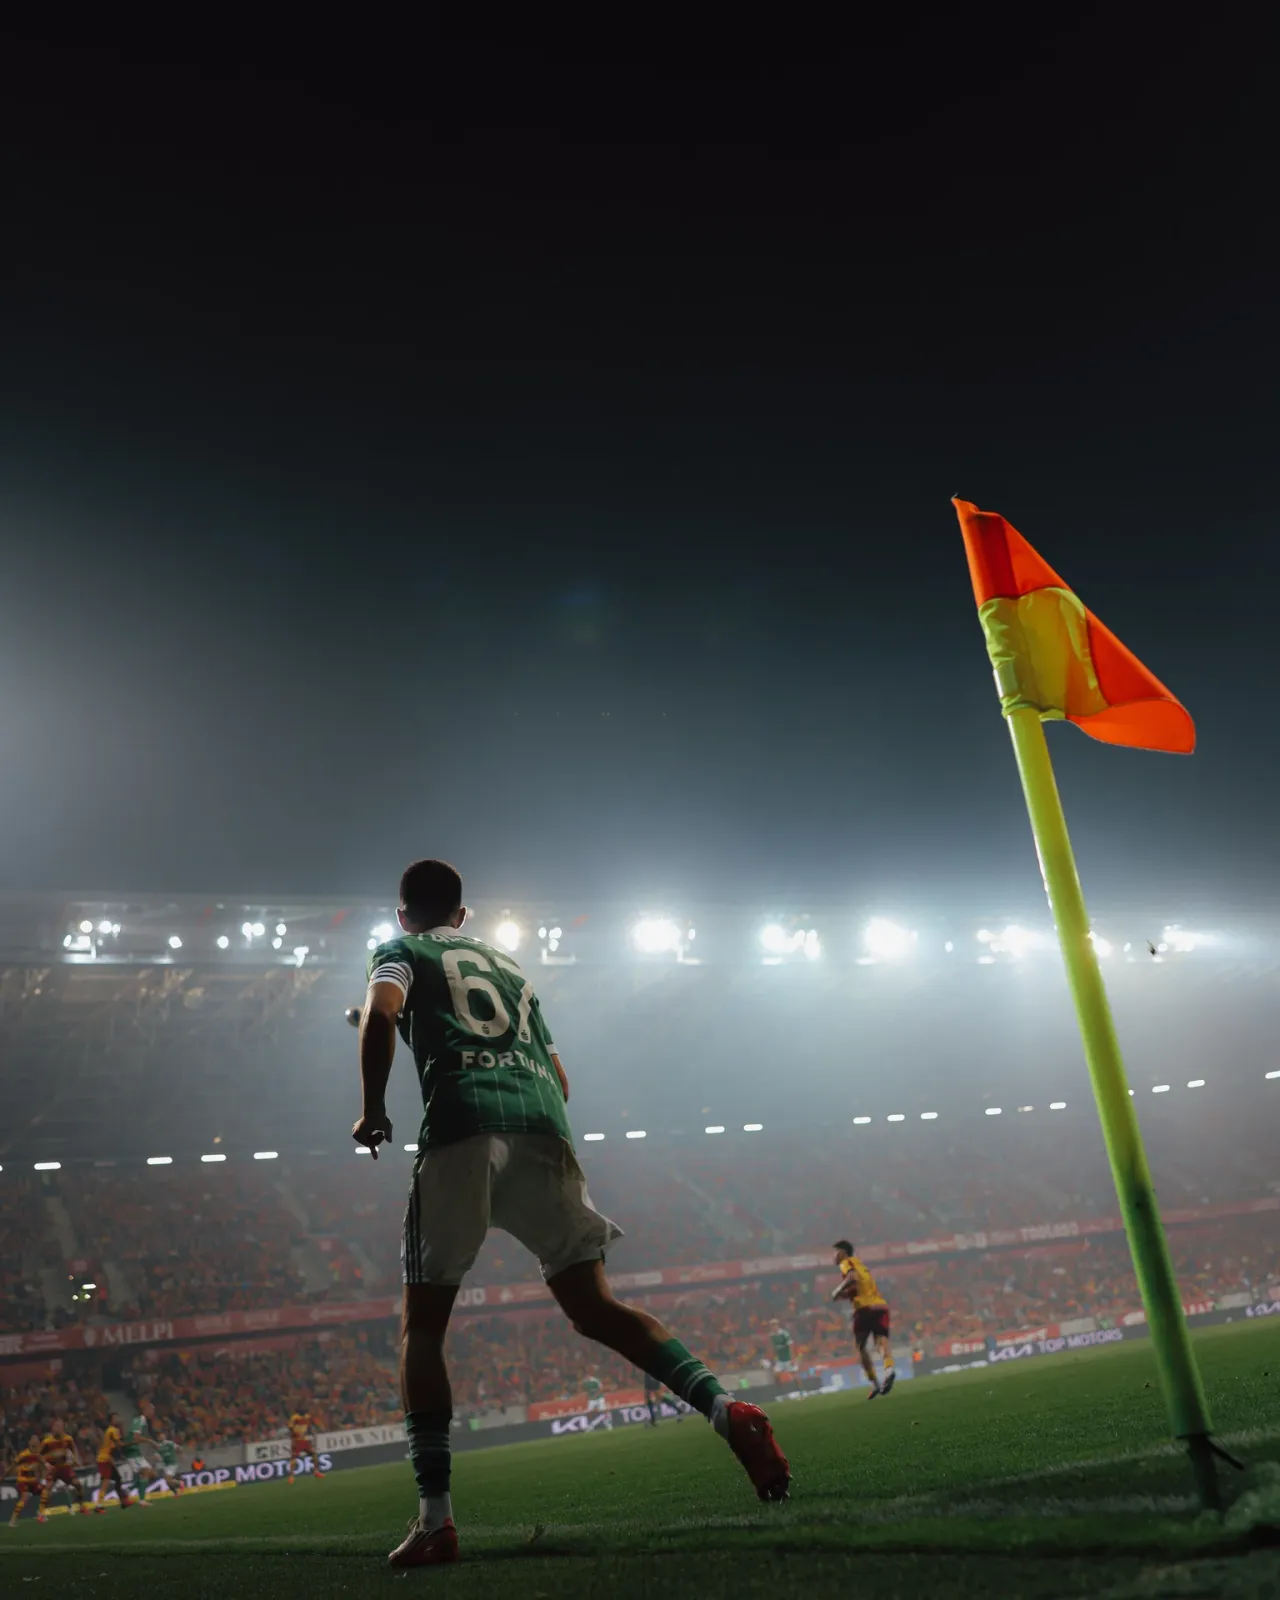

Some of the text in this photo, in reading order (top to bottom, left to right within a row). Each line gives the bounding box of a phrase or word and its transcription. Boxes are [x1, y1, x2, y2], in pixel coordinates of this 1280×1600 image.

[441, 948, 535, 1044] 67
[1037, 1337, 1066, 1353] TOP
[1067, 1327, 1123, 1347] MOTORS
[182, 1468, 230, 1489] TOP
